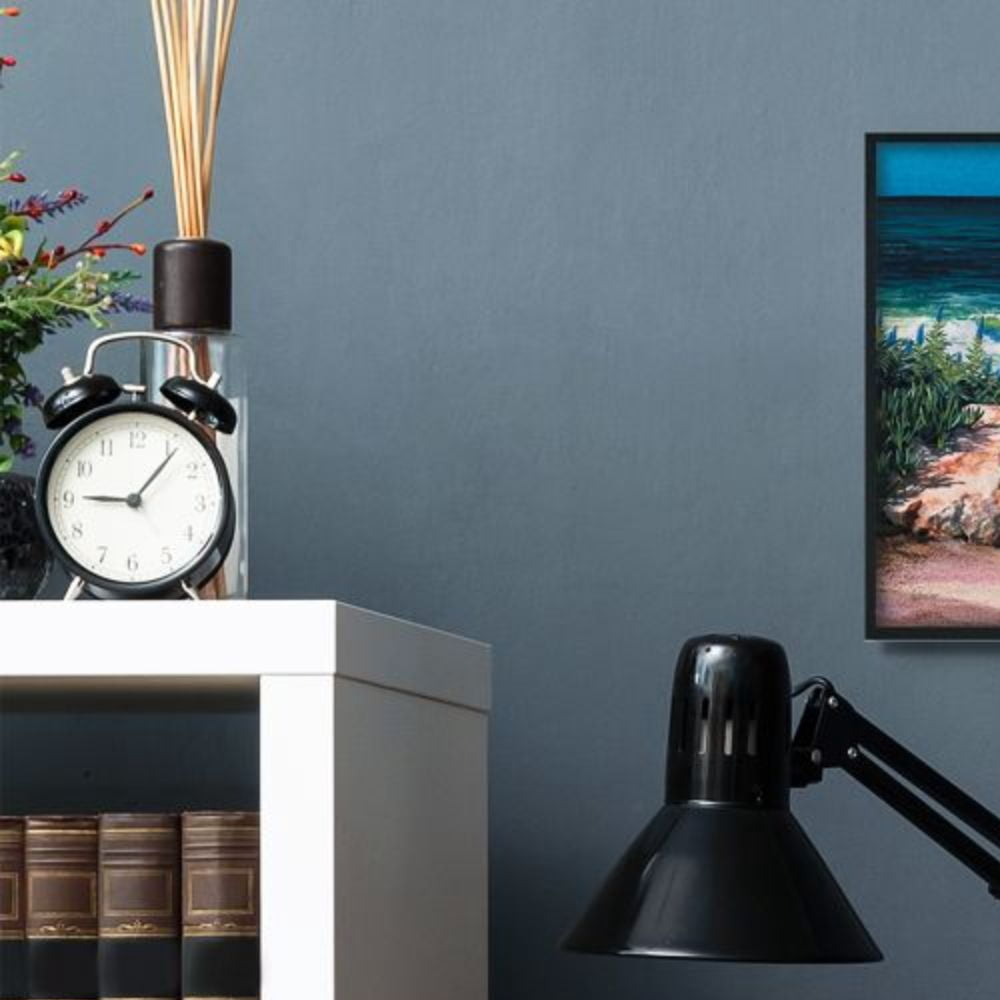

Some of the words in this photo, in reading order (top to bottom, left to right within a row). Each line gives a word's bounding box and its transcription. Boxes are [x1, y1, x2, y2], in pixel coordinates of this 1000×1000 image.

[101, 439, 113, 456] 11
[129, 431, 146, 448] 12
[77, 461, 93, 477] 10
[187, 463, 198, 479] 2
[63, 490, 74, 508] 9
[194, 496, 206, 512] 3
[72, 522, 83, 537] 8
[97, 546, 108, 564] 7
[127, 555, 138, 571] 6
[161, 548, 172, 564] 5
